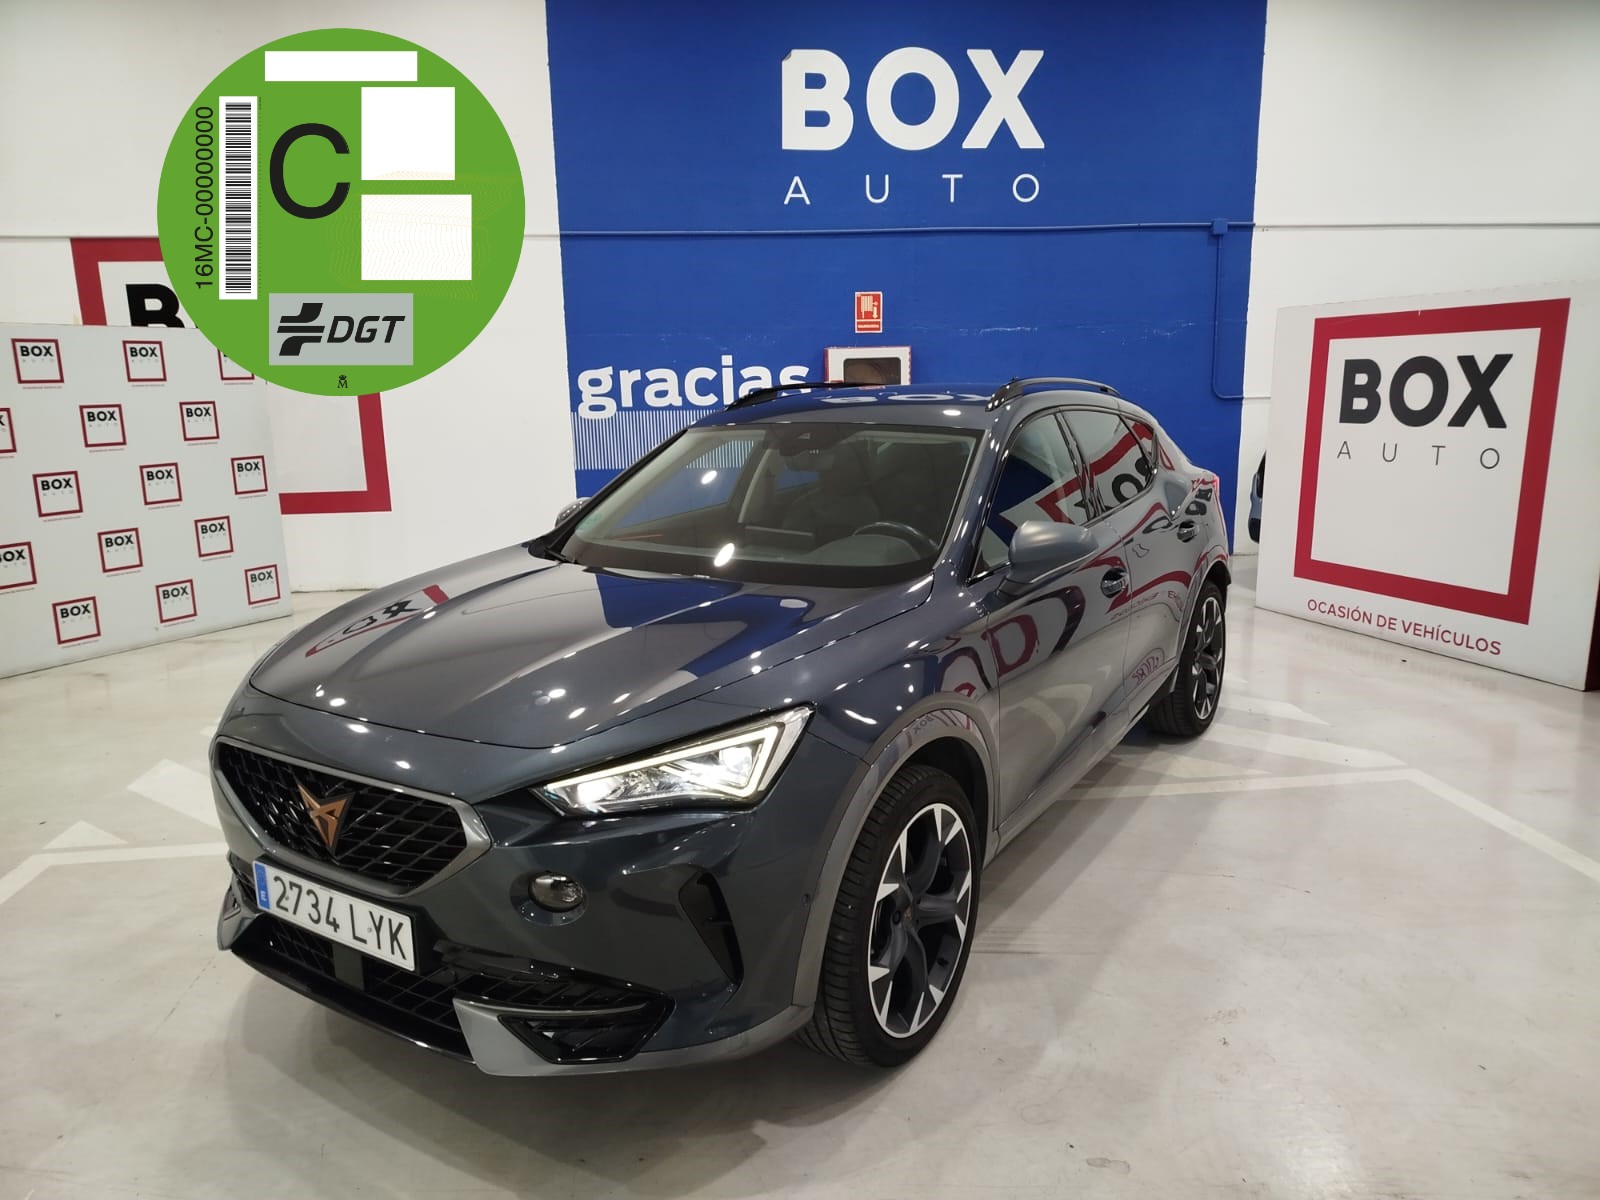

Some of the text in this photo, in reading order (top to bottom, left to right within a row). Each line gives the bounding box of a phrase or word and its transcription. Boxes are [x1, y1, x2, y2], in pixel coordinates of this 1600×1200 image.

[781, 46, 1045, 151] BOX
[783, 173, 1040, 206] AUTO
[20, 345, 54, 357] BOX
[129, 346, 158, 358] BOX
[577, 354, 812, 420] gracias
[1339, 353, 1514, 429] BOX
[86, 411, 117, 422] BOX
[186, 406, 212, 418] BOX
[1336, 440, 1501, 470] AUTO
[236, 461, 261, 473] BOX
[145, 469, 174, 481] BOX
[40, 477, 73, 491] BOX
[200, 521, 226, 534] BOX
[104, 534, 134, 548] BOX
[249, 570, 274, 583] BOX
[161, 585, 189, 599] BOX
[59, 603, 91, 619] BOX
[1307, 598, 1502, 656] OCASIÓN DE VEHÍCULOS
[273, 875, 407, 961] 2734 LYK
